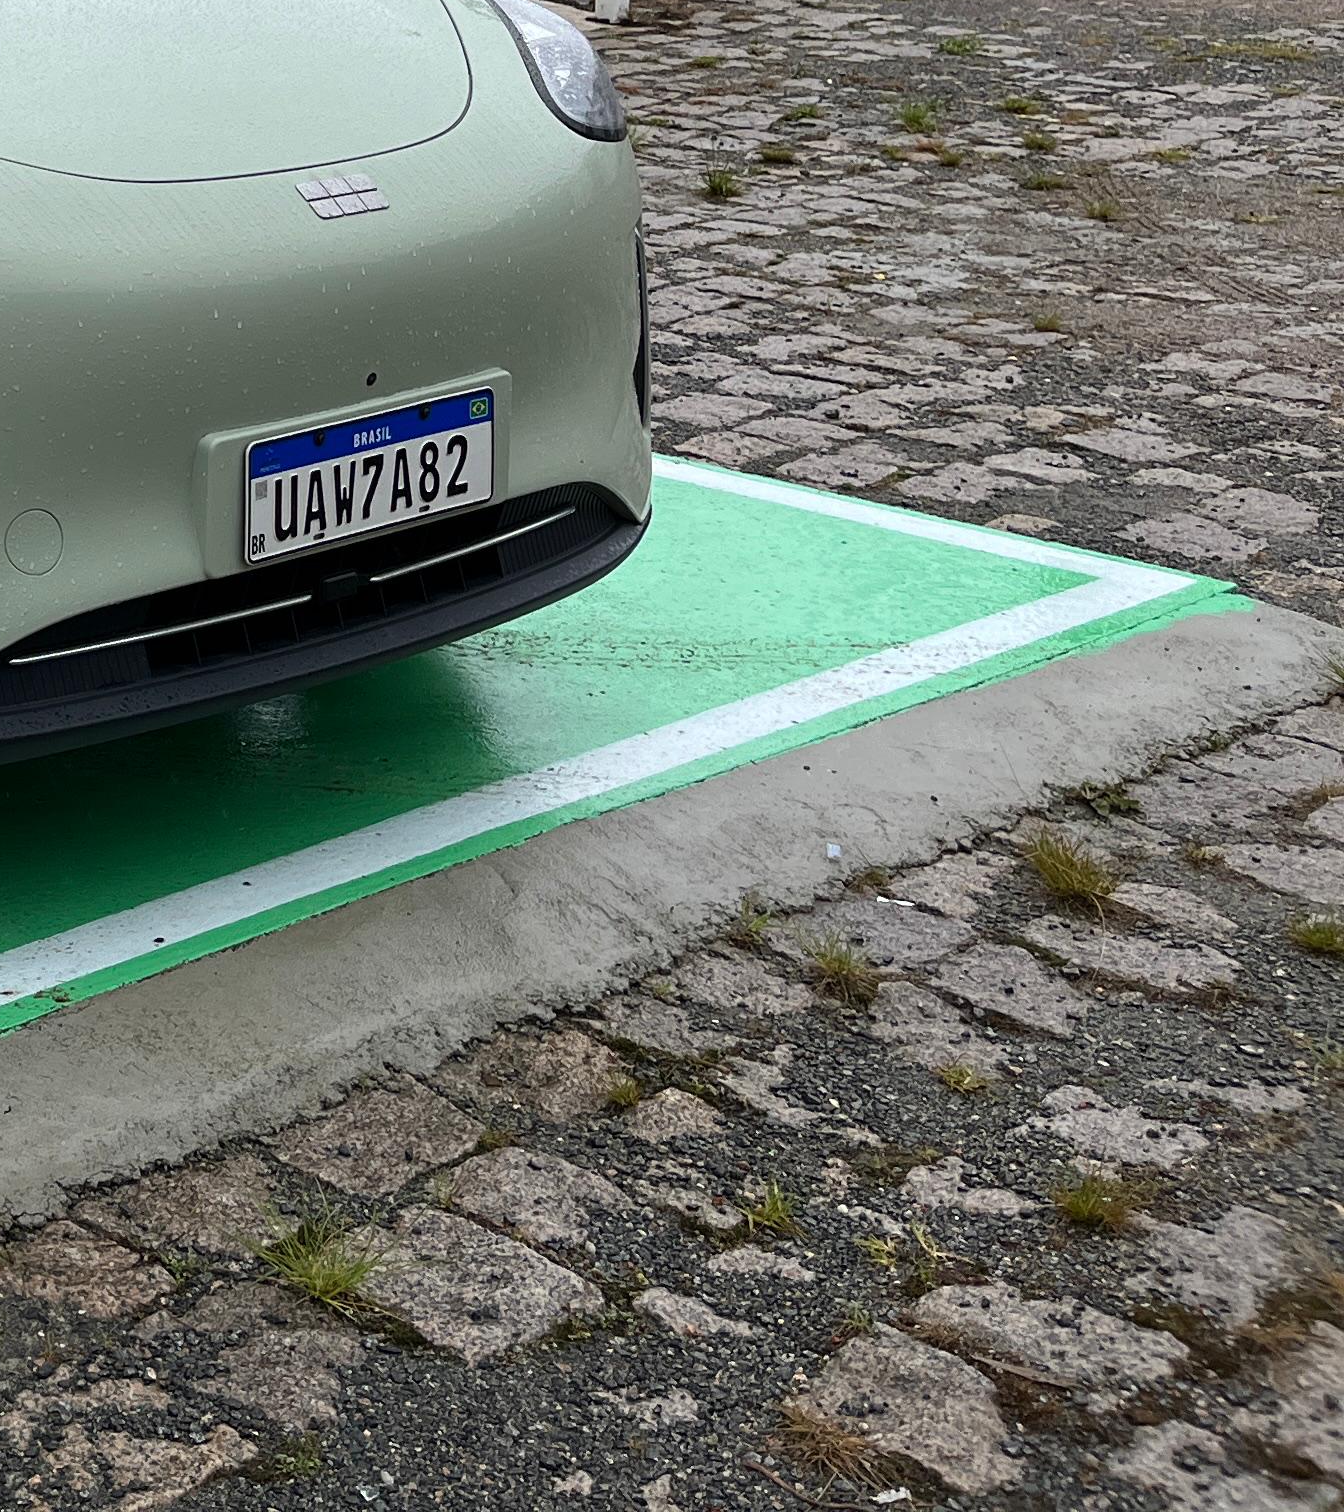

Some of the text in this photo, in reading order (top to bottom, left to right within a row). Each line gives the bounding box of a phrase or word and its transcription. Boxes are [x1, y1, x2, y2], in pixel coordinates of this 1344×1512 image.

[353, 425, 392, 448] BRASIL
[274, 434, 468, 542] UAW7A82
[251, 532, 266, 555] BR
